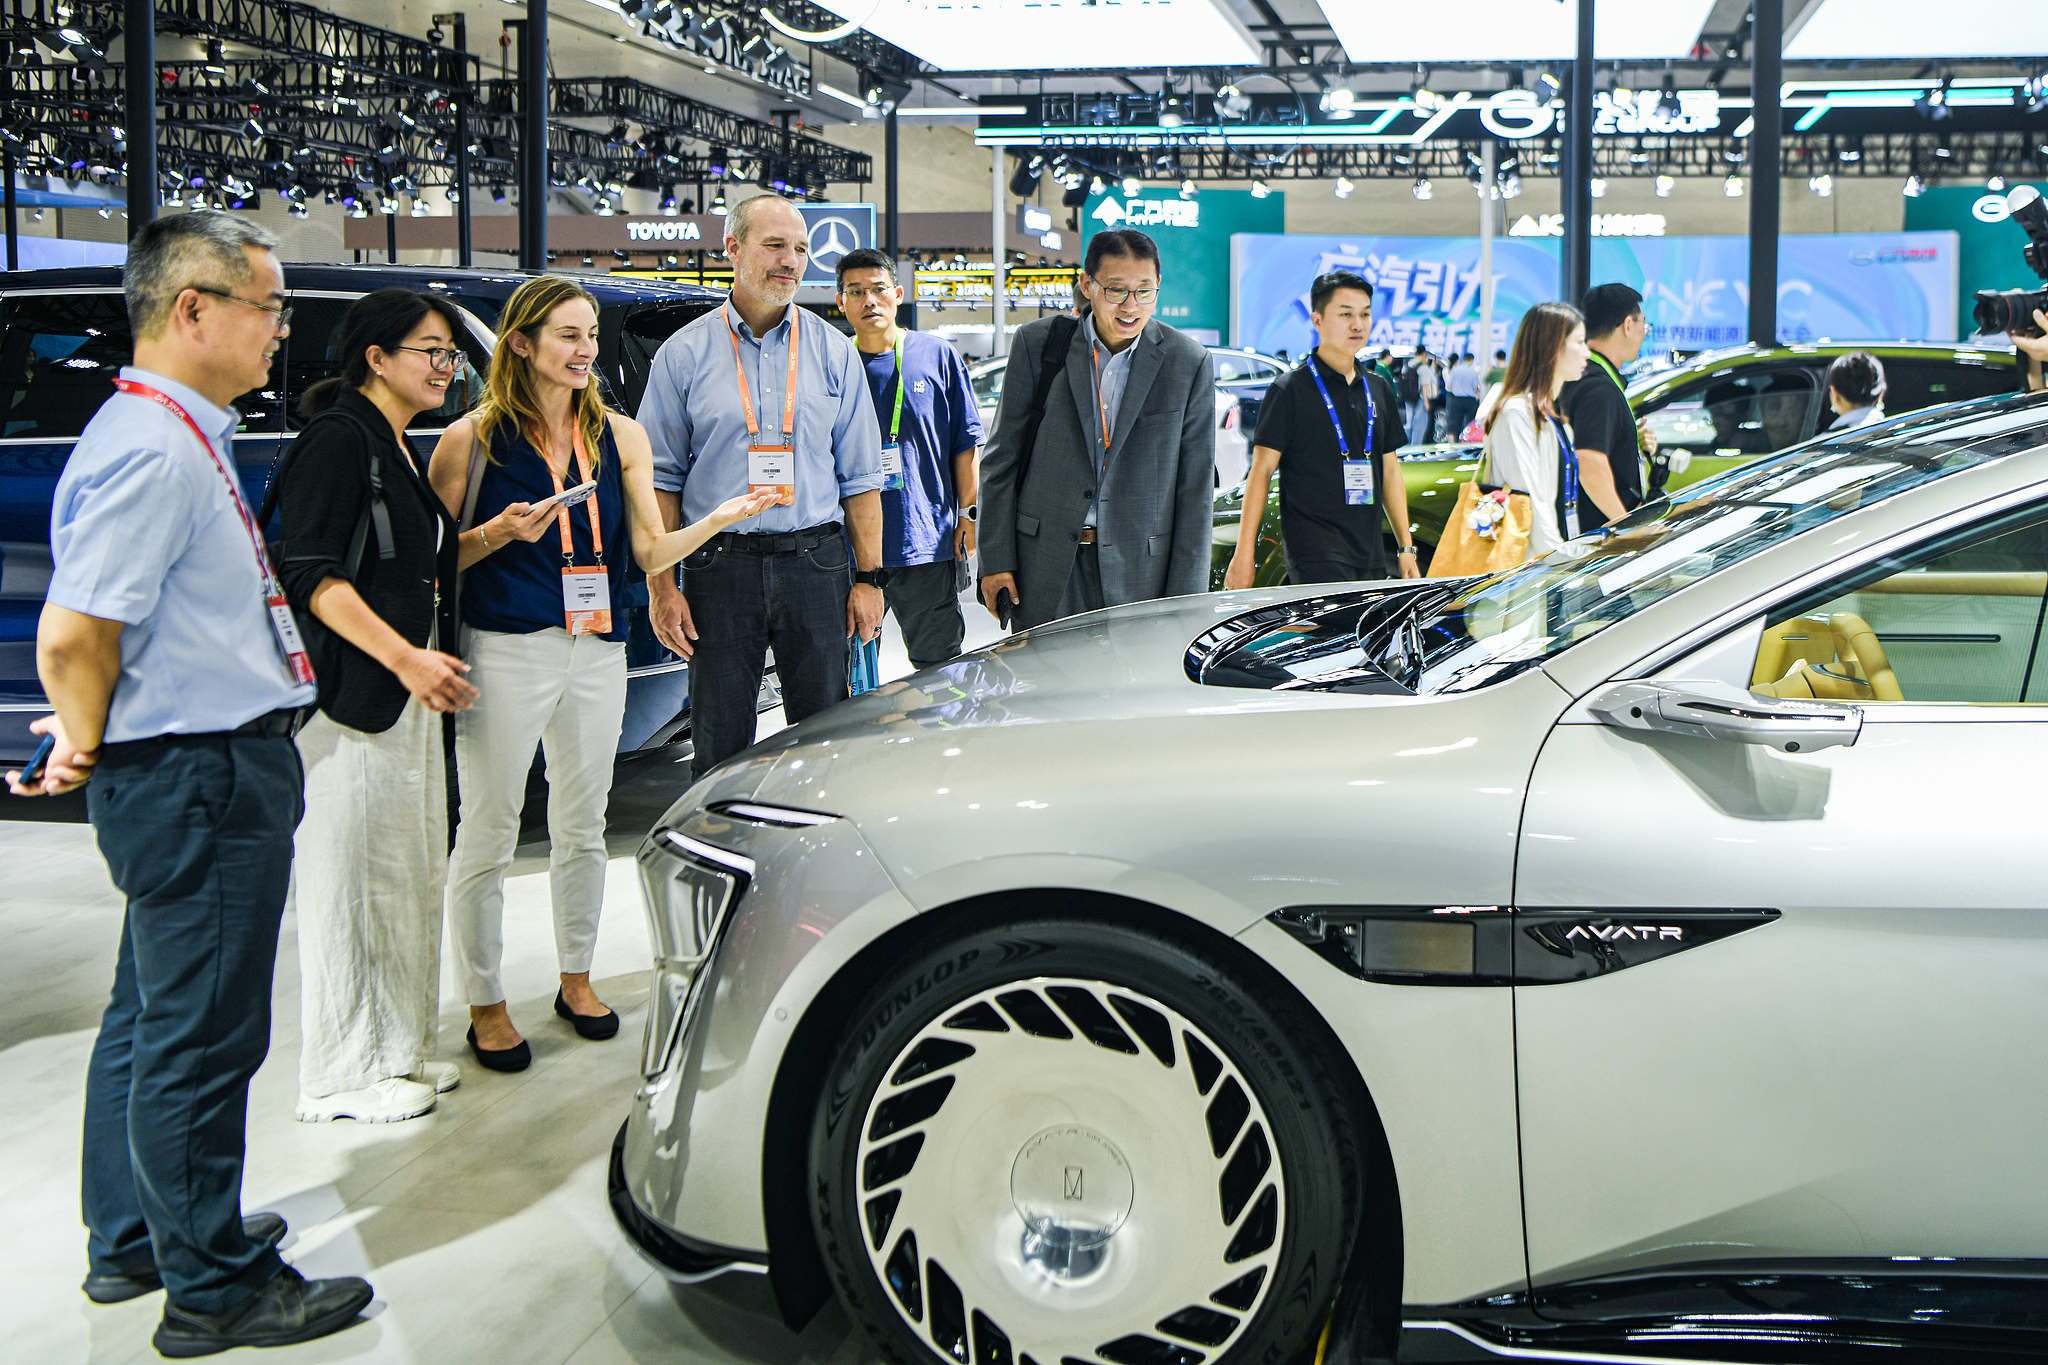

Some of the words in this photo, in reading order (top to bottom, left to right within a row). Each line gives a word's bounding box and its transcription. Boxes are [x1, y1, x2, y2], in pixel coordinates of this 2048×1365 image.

[626, 222, 701, 240] TOYOTA
[1565, 925, 1683, 941] AVATR
[860, 947, 981, 1056] DUNLOP
